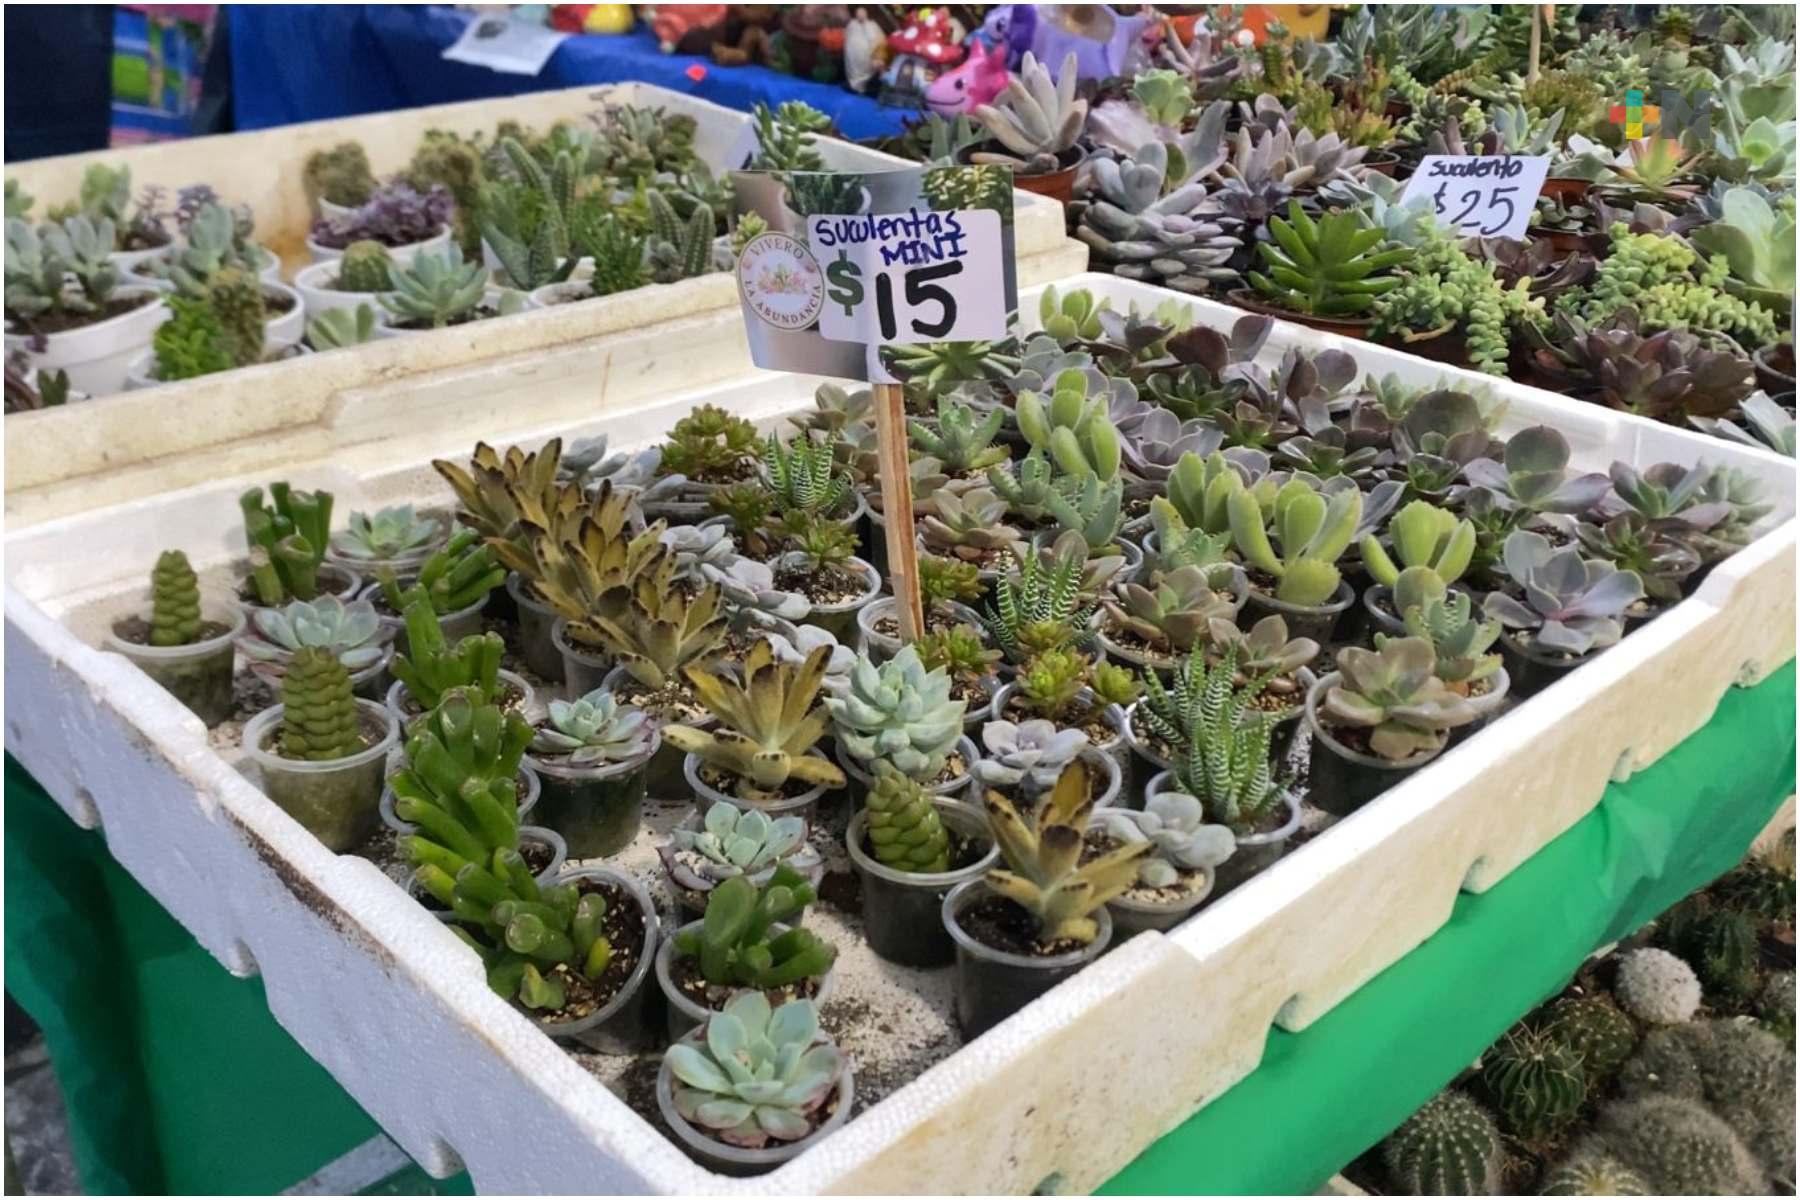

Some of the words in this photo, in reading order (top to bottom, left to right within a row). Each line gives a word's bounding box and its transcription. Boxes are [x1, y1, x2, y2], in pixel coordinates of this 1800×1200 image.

[749, 237, 804, 260] VIVERO
[879, 231, 968, 266] MINI
[744, 280, 756, 297] LA
[755, 285, 822, 324] ABUNDANCIA
